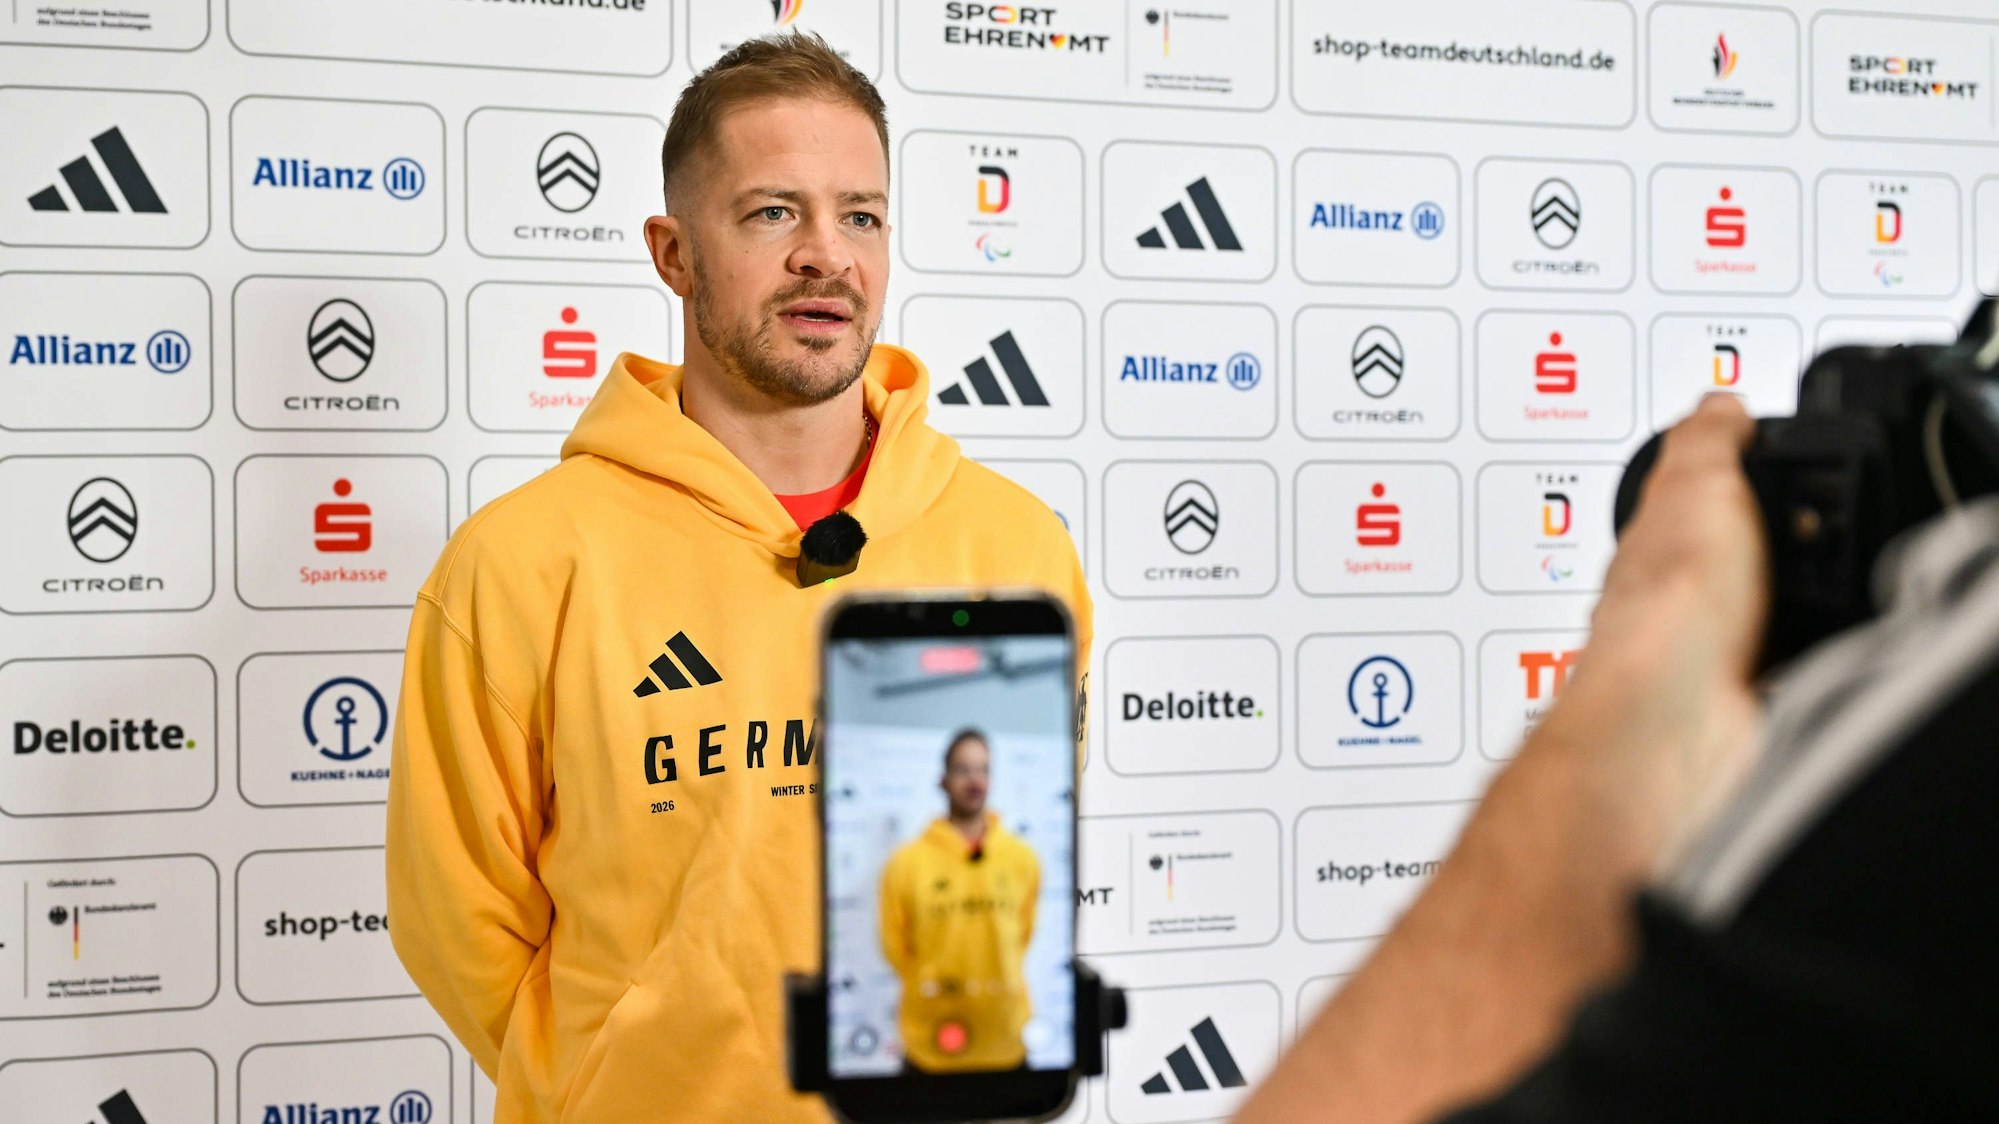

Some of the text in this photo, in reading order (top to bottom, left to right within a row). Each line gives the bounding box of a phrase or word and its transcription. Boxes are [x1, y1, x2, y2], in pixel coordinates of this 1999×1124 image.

[946, 2, 1056, 26] SPORT
[1313, 34, 1615, 71] shop-teamdeutschland.de
[1849, 55, 1936, 75] SPORT
[970, 145, 1018, 157] TEAM
[253, 158, 373, 190] Allianz
[1869, 182, 1910, 194] TEAM
[1310, 203, 1403, 231] Allianz
[514, 226, 624, 242] CITROËN
[1707, 325, 1747, 336] TEAM
[10, 335, 136, 365] Allianz
[1120, 356, 1218, 382] Allianz
[284, 395, 399, 411] CITROËN
[1536, 474, 1579, 484] TEAM
[299, 566, 388, 585] Sparkasse
[1144, 565, 1239, 581] CITROËN
[1344, 559, 1413, 575] Sparkasse
[42, 575, 164, 593] CITROËN
[1123, 691, 1264, 721] Deloitte.
[14, 718, 196, 755] Deloitte.
[771, 783, 818, 797] WINTER S
[651, 800, 675, 813] 2026
[262, 1103, 380, 1124] Allianz
